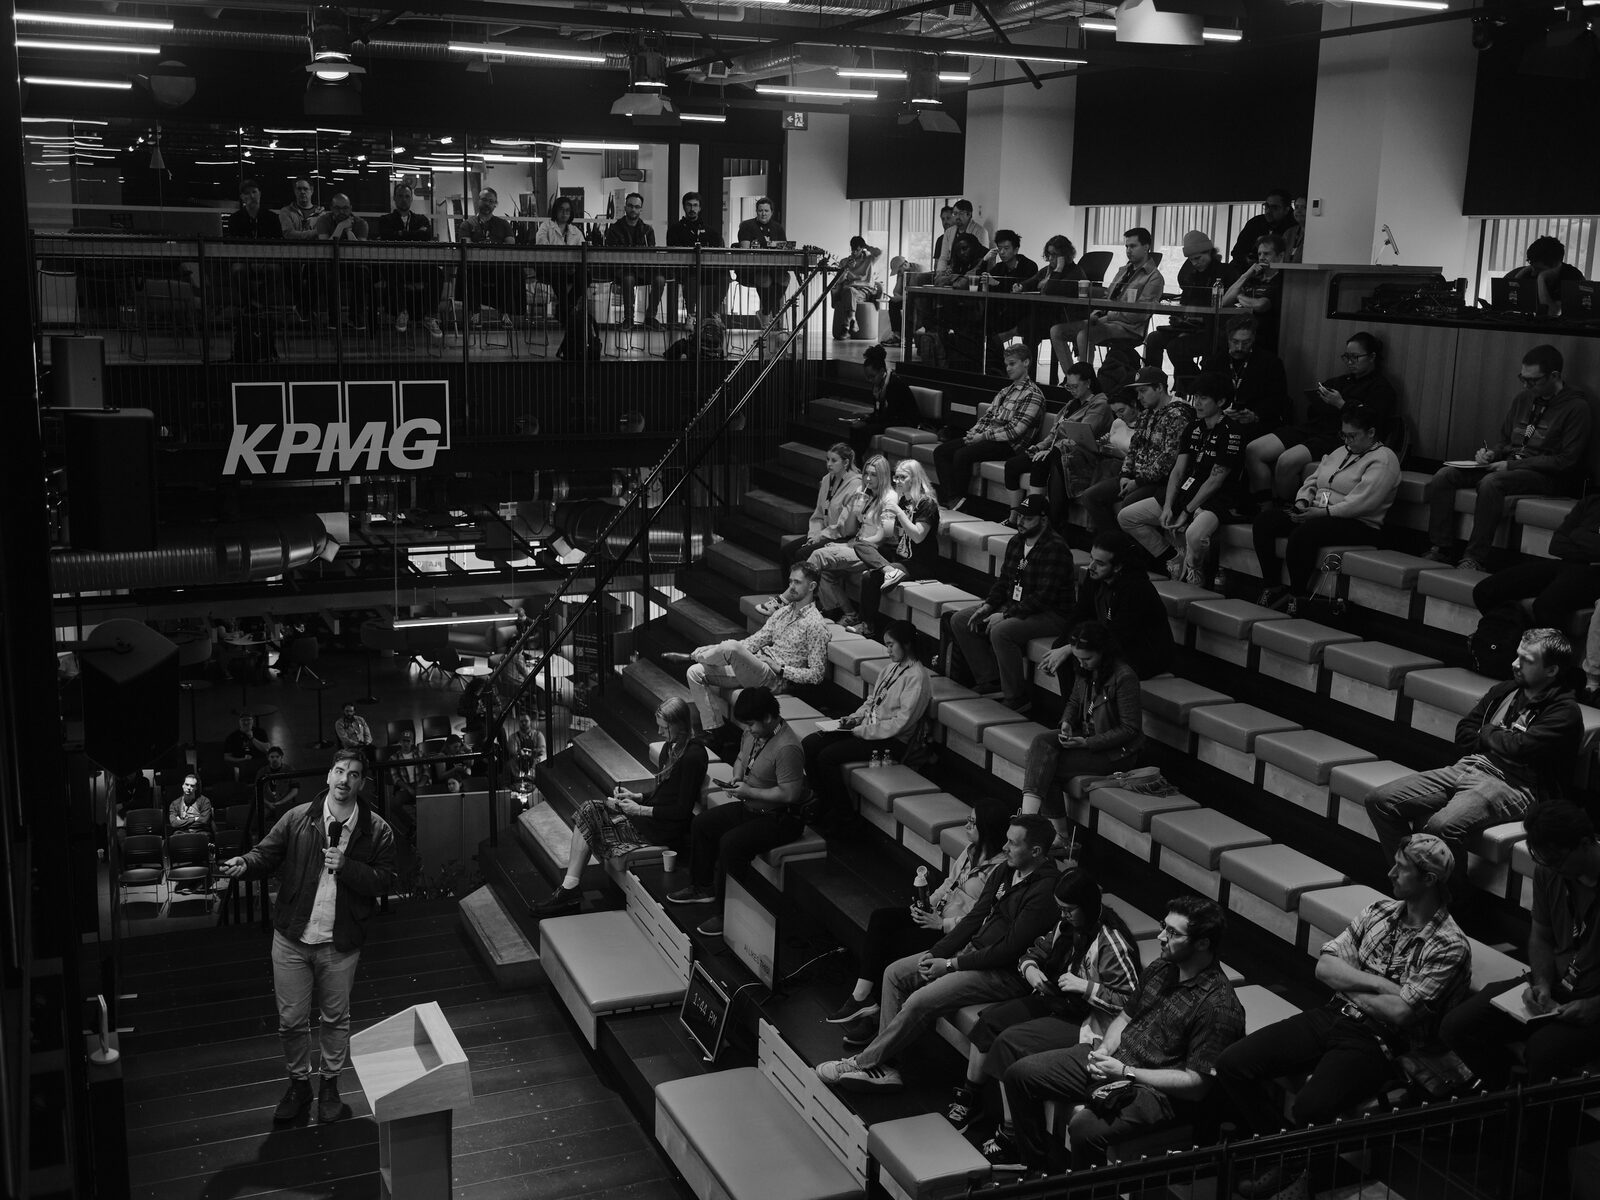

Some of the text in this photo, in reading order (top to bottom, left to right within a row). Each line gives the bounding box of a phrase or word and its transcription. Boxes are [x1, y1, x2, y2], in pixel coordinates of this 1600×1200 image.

[222, 418, 442, 475] KPMG
[692, 992, 718, 1028] 1:44 PM
